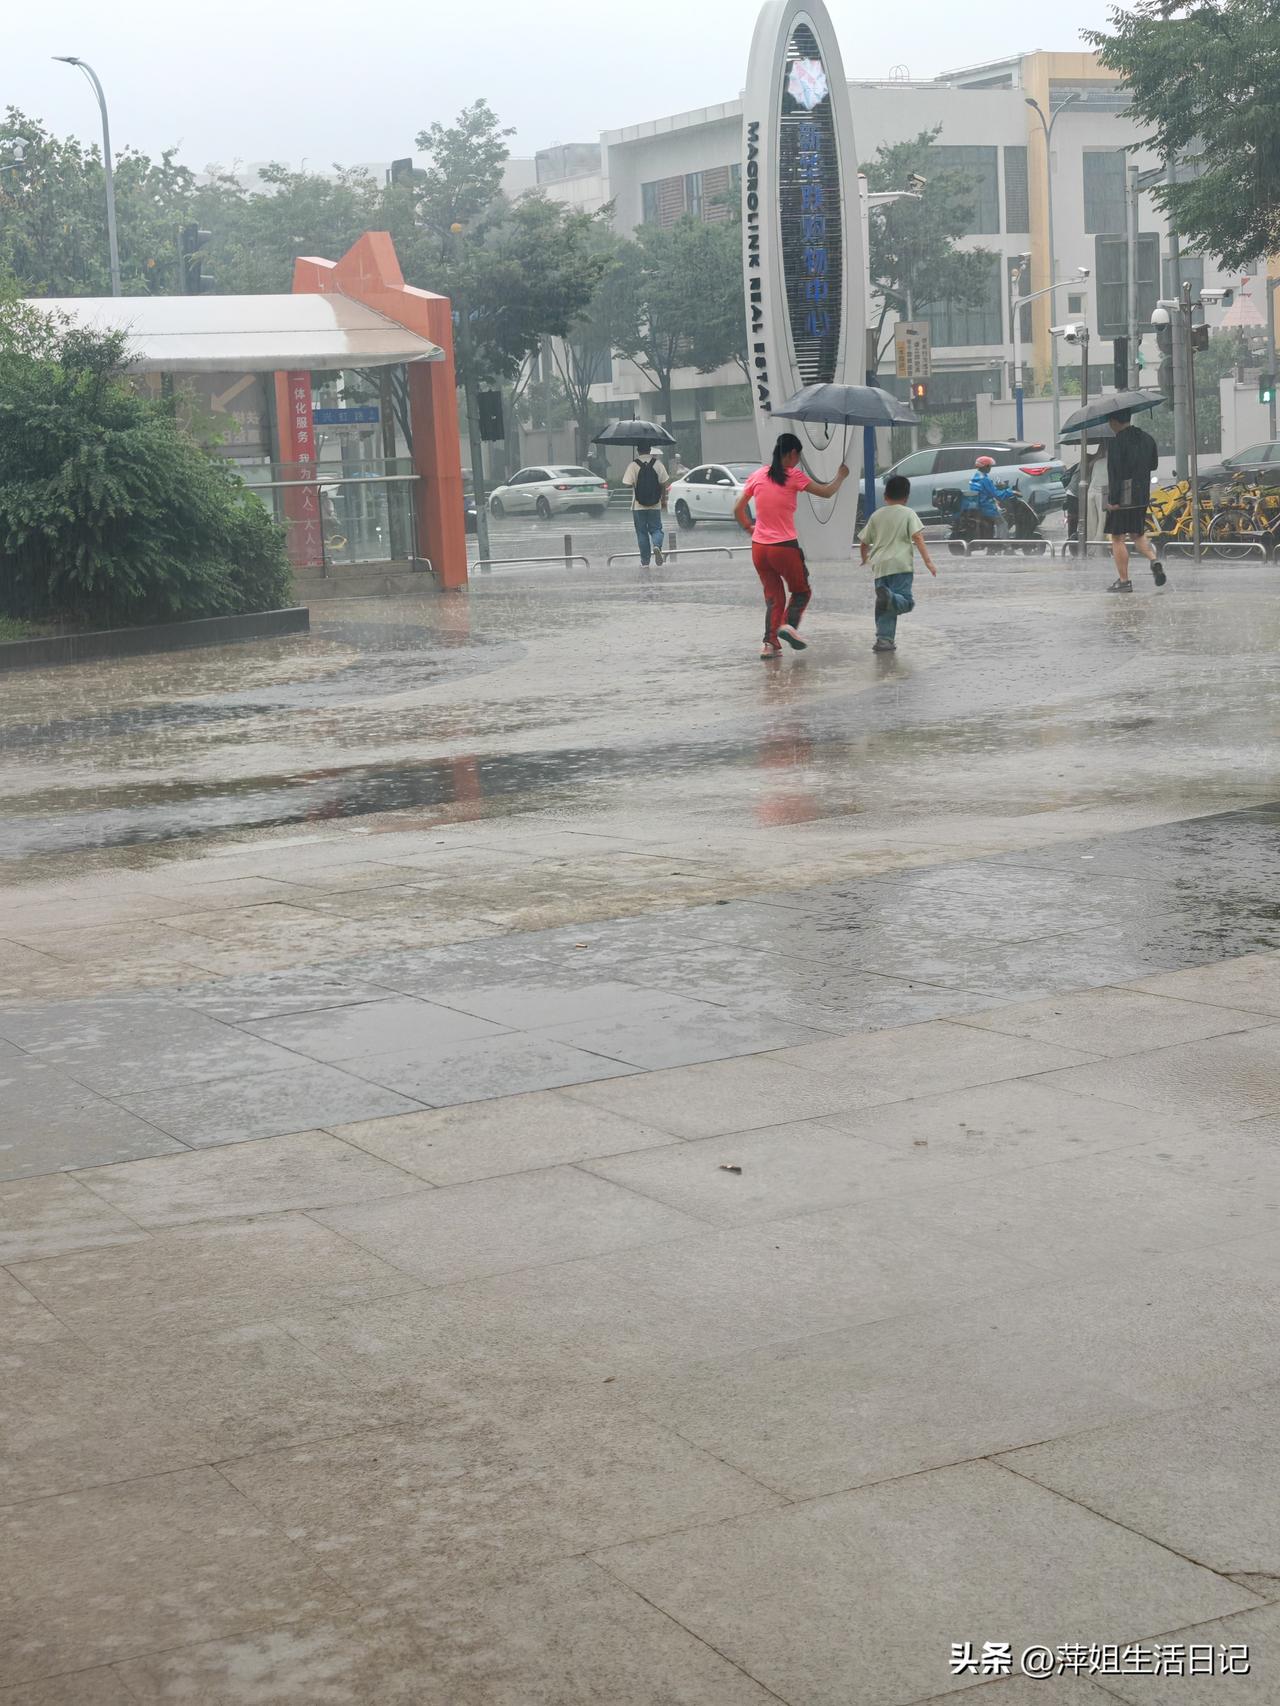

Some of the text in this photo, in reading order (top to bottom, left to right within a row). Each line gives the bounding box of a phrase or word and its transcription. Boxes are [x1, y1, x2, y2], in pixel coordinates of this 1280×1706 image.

[747, 121, 760, 268] MACROLINK
[799, 122, 829, 337] 新华联购物中心
[750, 277, 763, 333] REAL
[292, 377, 309, 444] 一体化服务
